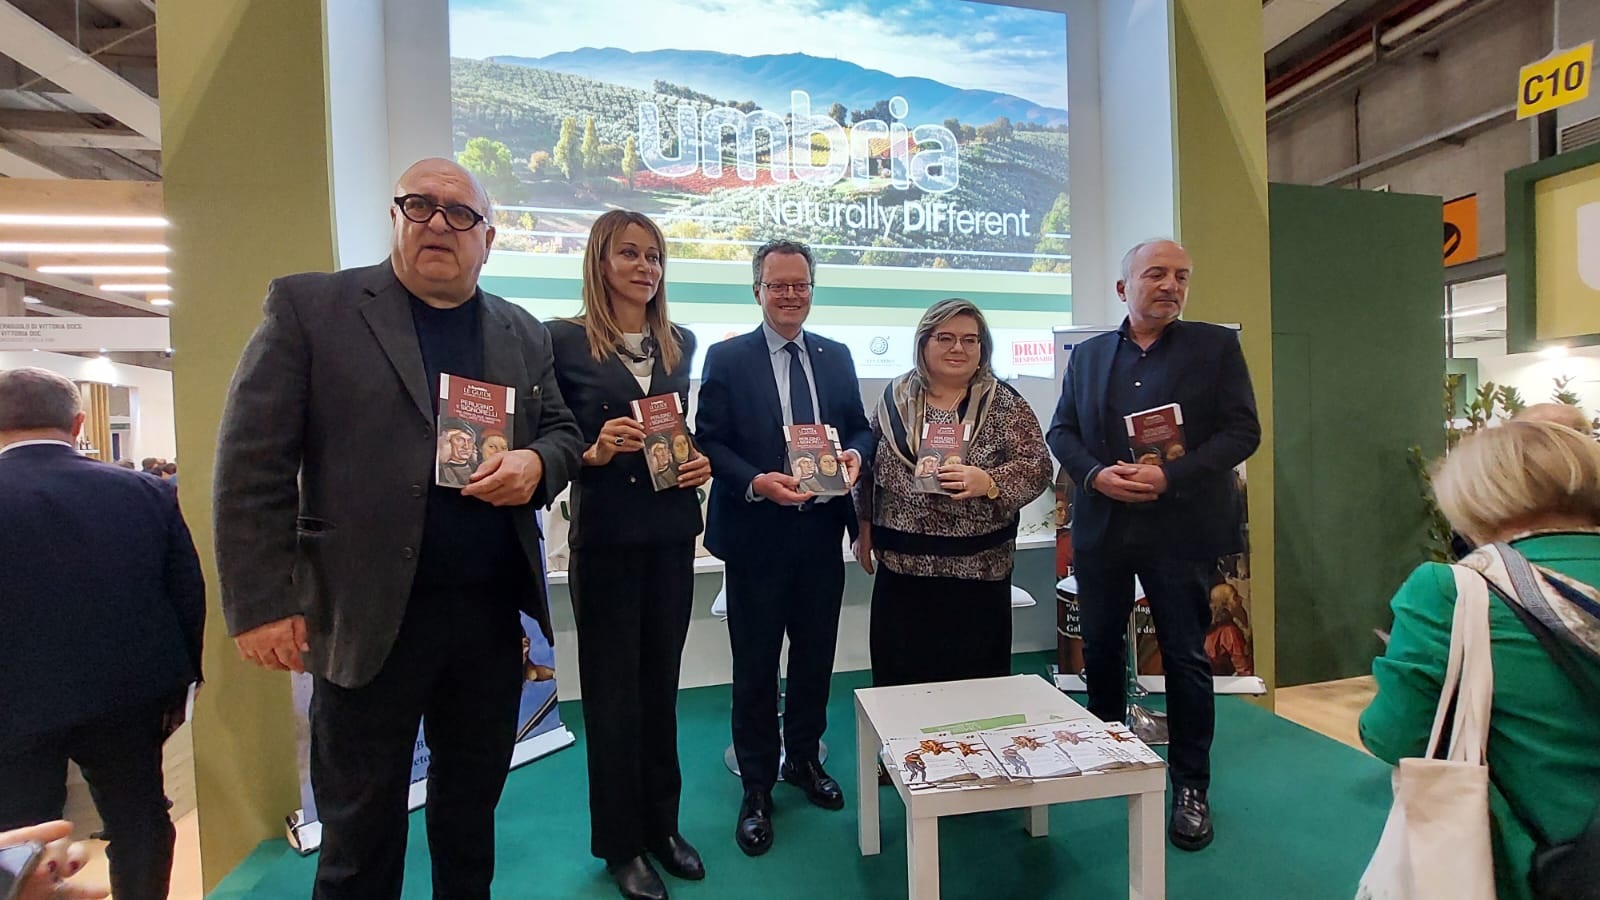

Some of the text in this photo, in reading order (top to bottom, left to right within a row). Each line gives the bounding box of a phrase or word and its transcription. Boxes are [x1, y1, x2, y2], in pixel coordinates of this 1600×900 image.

[1524, 61, 1584, 105] C10
[639, 90, 959, 193] umbria
[759, 196, 1030, 239] Naturally DIFferent
